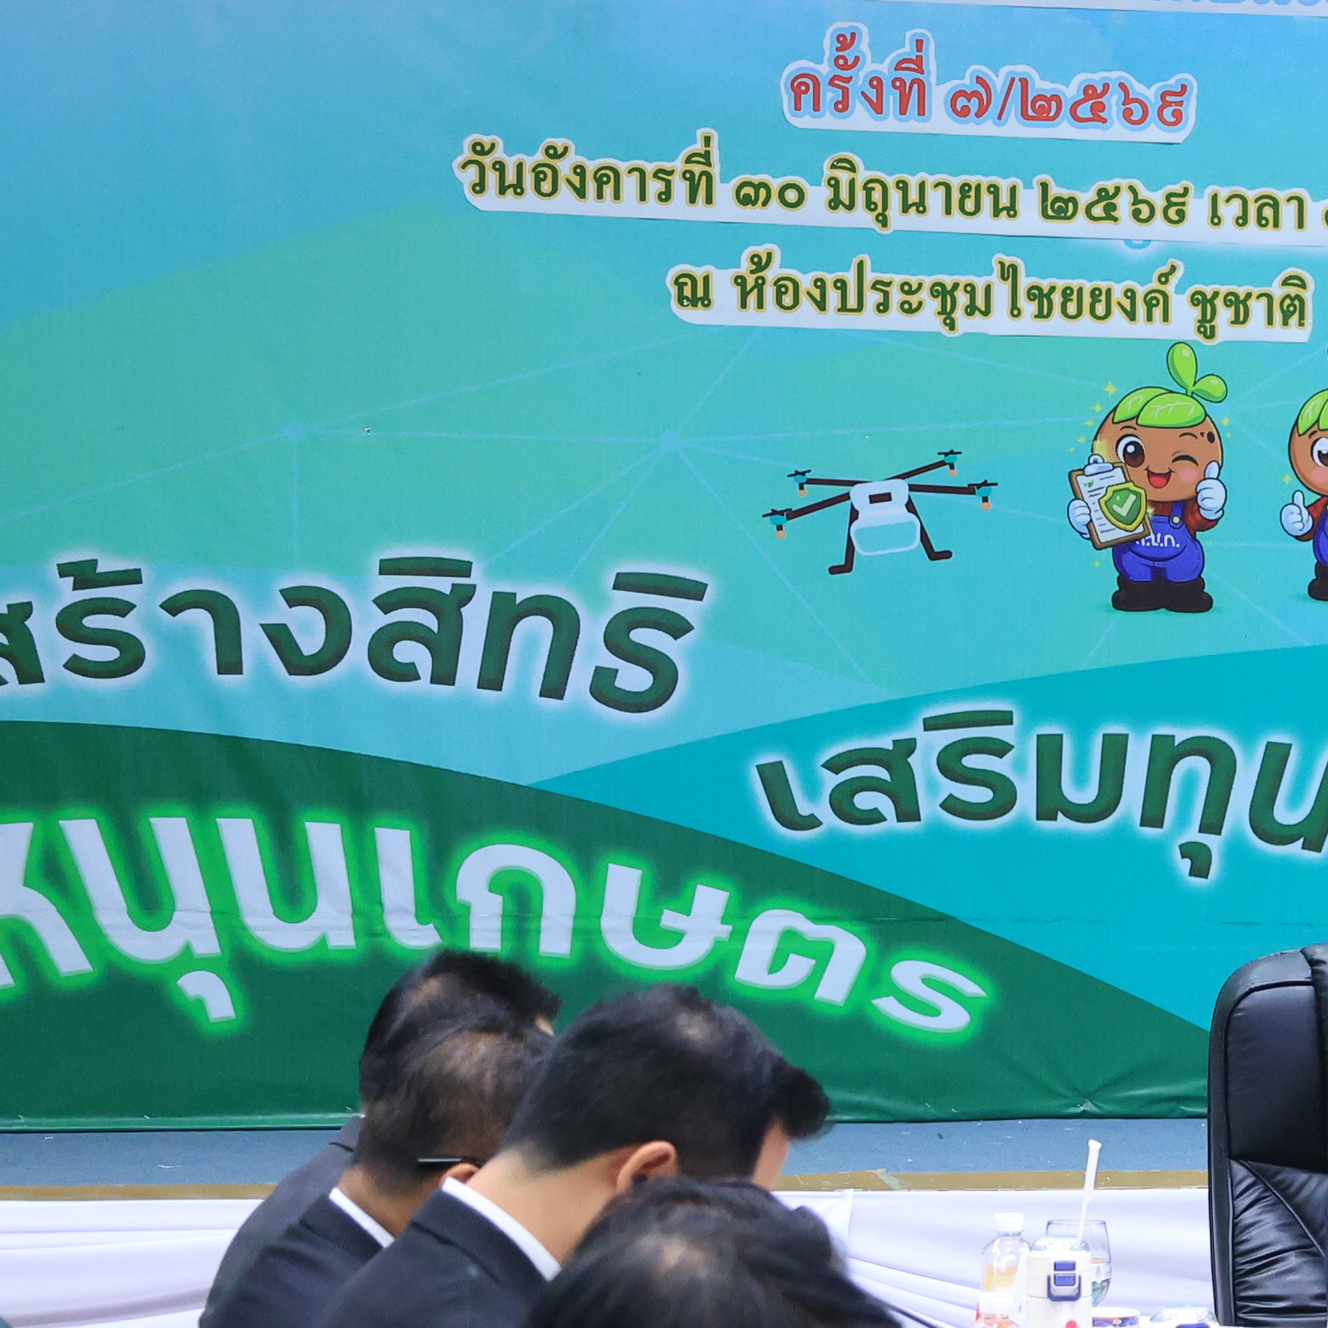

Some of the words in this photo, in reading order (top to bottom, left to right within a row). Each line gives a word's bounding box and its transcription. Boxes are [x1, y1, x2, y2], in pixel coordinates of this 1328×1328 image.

[789, 32, 926, 117] ครั้งที่
[949, 75, 1188, 126] ๗/๒๕๖๙
[458, 134, 715, 206] วันอังคารที่
[733, 178, 807, 210] ๓๐
[825, 156, 1019, 230] มิถุนายน
[1039, 180, 1192, 226] ๒๕๖๙
[1208, 190, 1307, 230] เวลา
[673, 269, 713, 310] ณ
[1189, 273, 1308, 340] ชูชาติ
